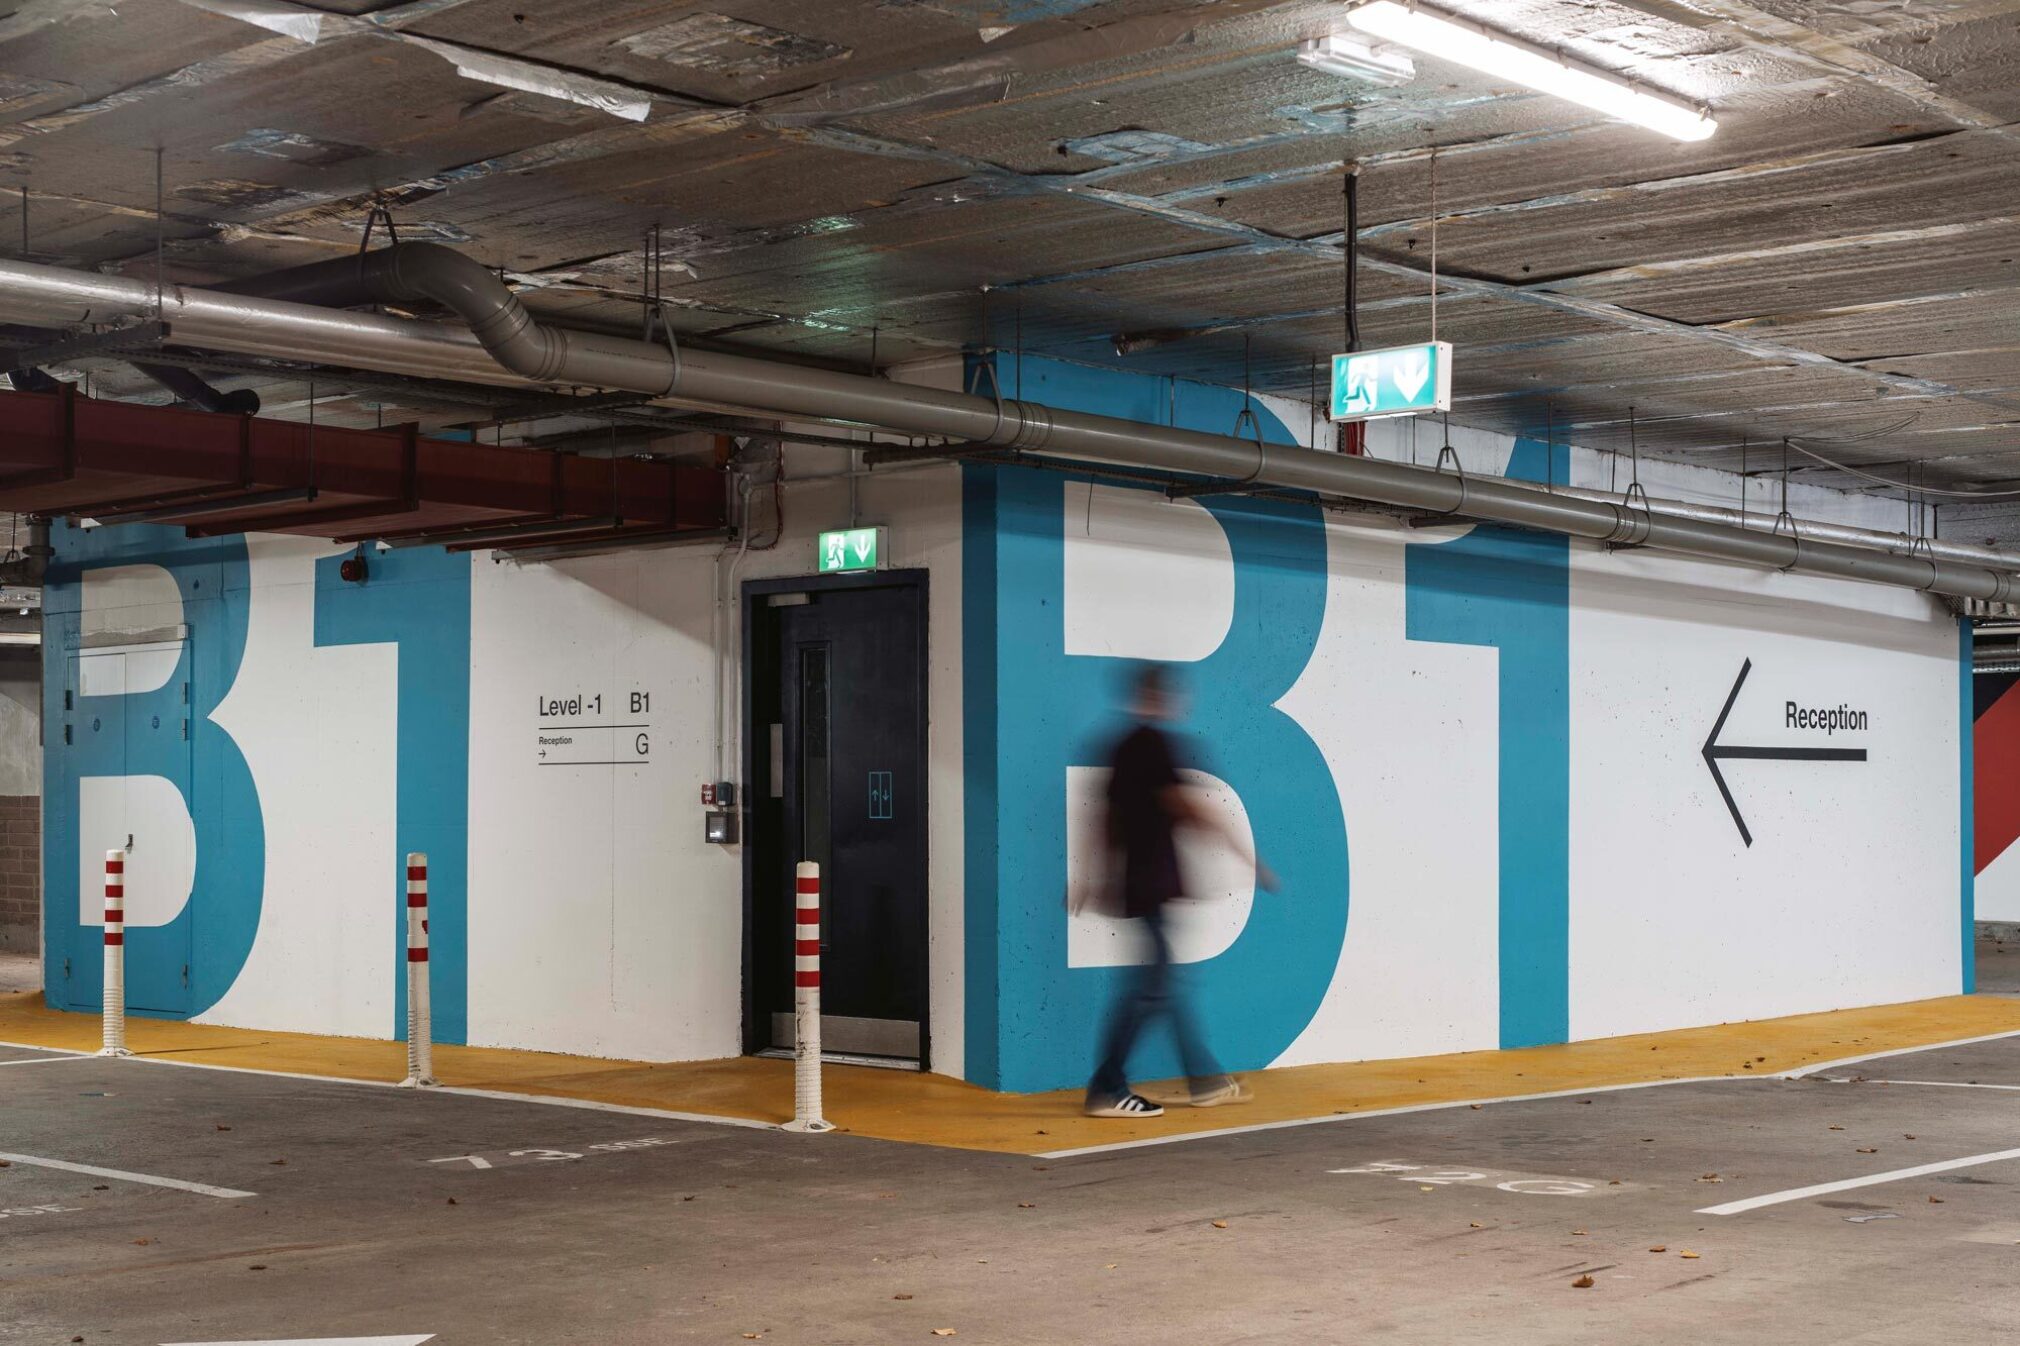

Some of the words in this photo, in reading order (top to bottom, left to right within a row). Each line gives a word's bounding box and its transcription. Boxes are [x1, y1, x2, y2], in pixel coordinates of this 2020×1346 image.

[538, 694, 582, 717] Level
[587, 693, 602, 715] -1
[630, 691, 650, 714] B1
[963, 345, 1570, 1095] B1
[1785, 700, 1868, 736] Reception
[44, 431, 472, 1045] B1
[538, 736, 573, 748] Reception
[635, 732, 649, 755] G
[0, 1203, 83, 1218] SE
